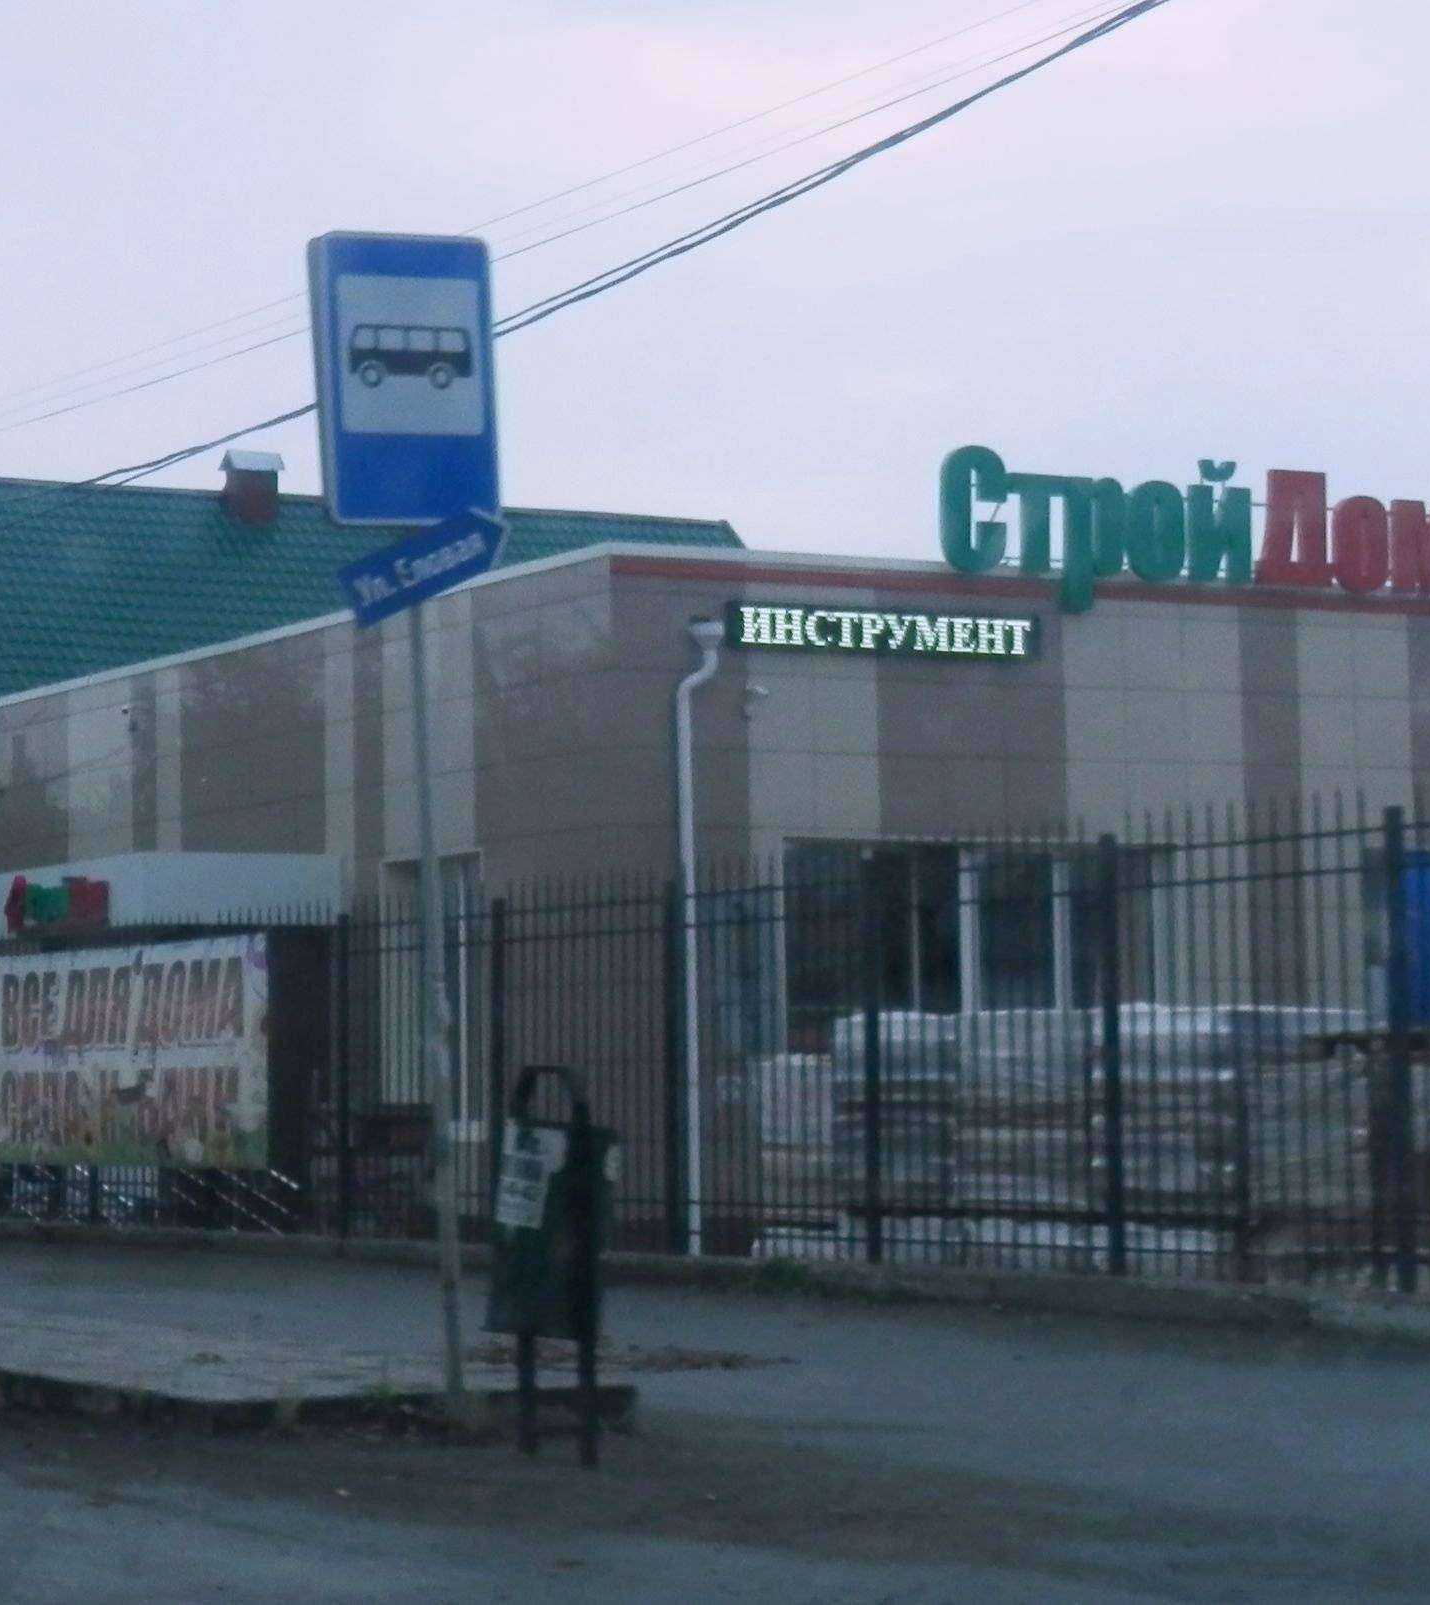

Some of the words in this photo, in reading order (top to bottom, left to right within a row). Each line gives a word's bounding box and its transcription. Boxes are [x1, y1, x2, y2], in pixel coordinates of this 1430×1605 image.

[739, 606, 1031, 656] ИНСТРУМЕНТ
[2, 971, 60, 1048] ВСЕ
[62, 966, 131, 1049] ДЛЯ
[135, 956, 244, 1047] ДОМА
